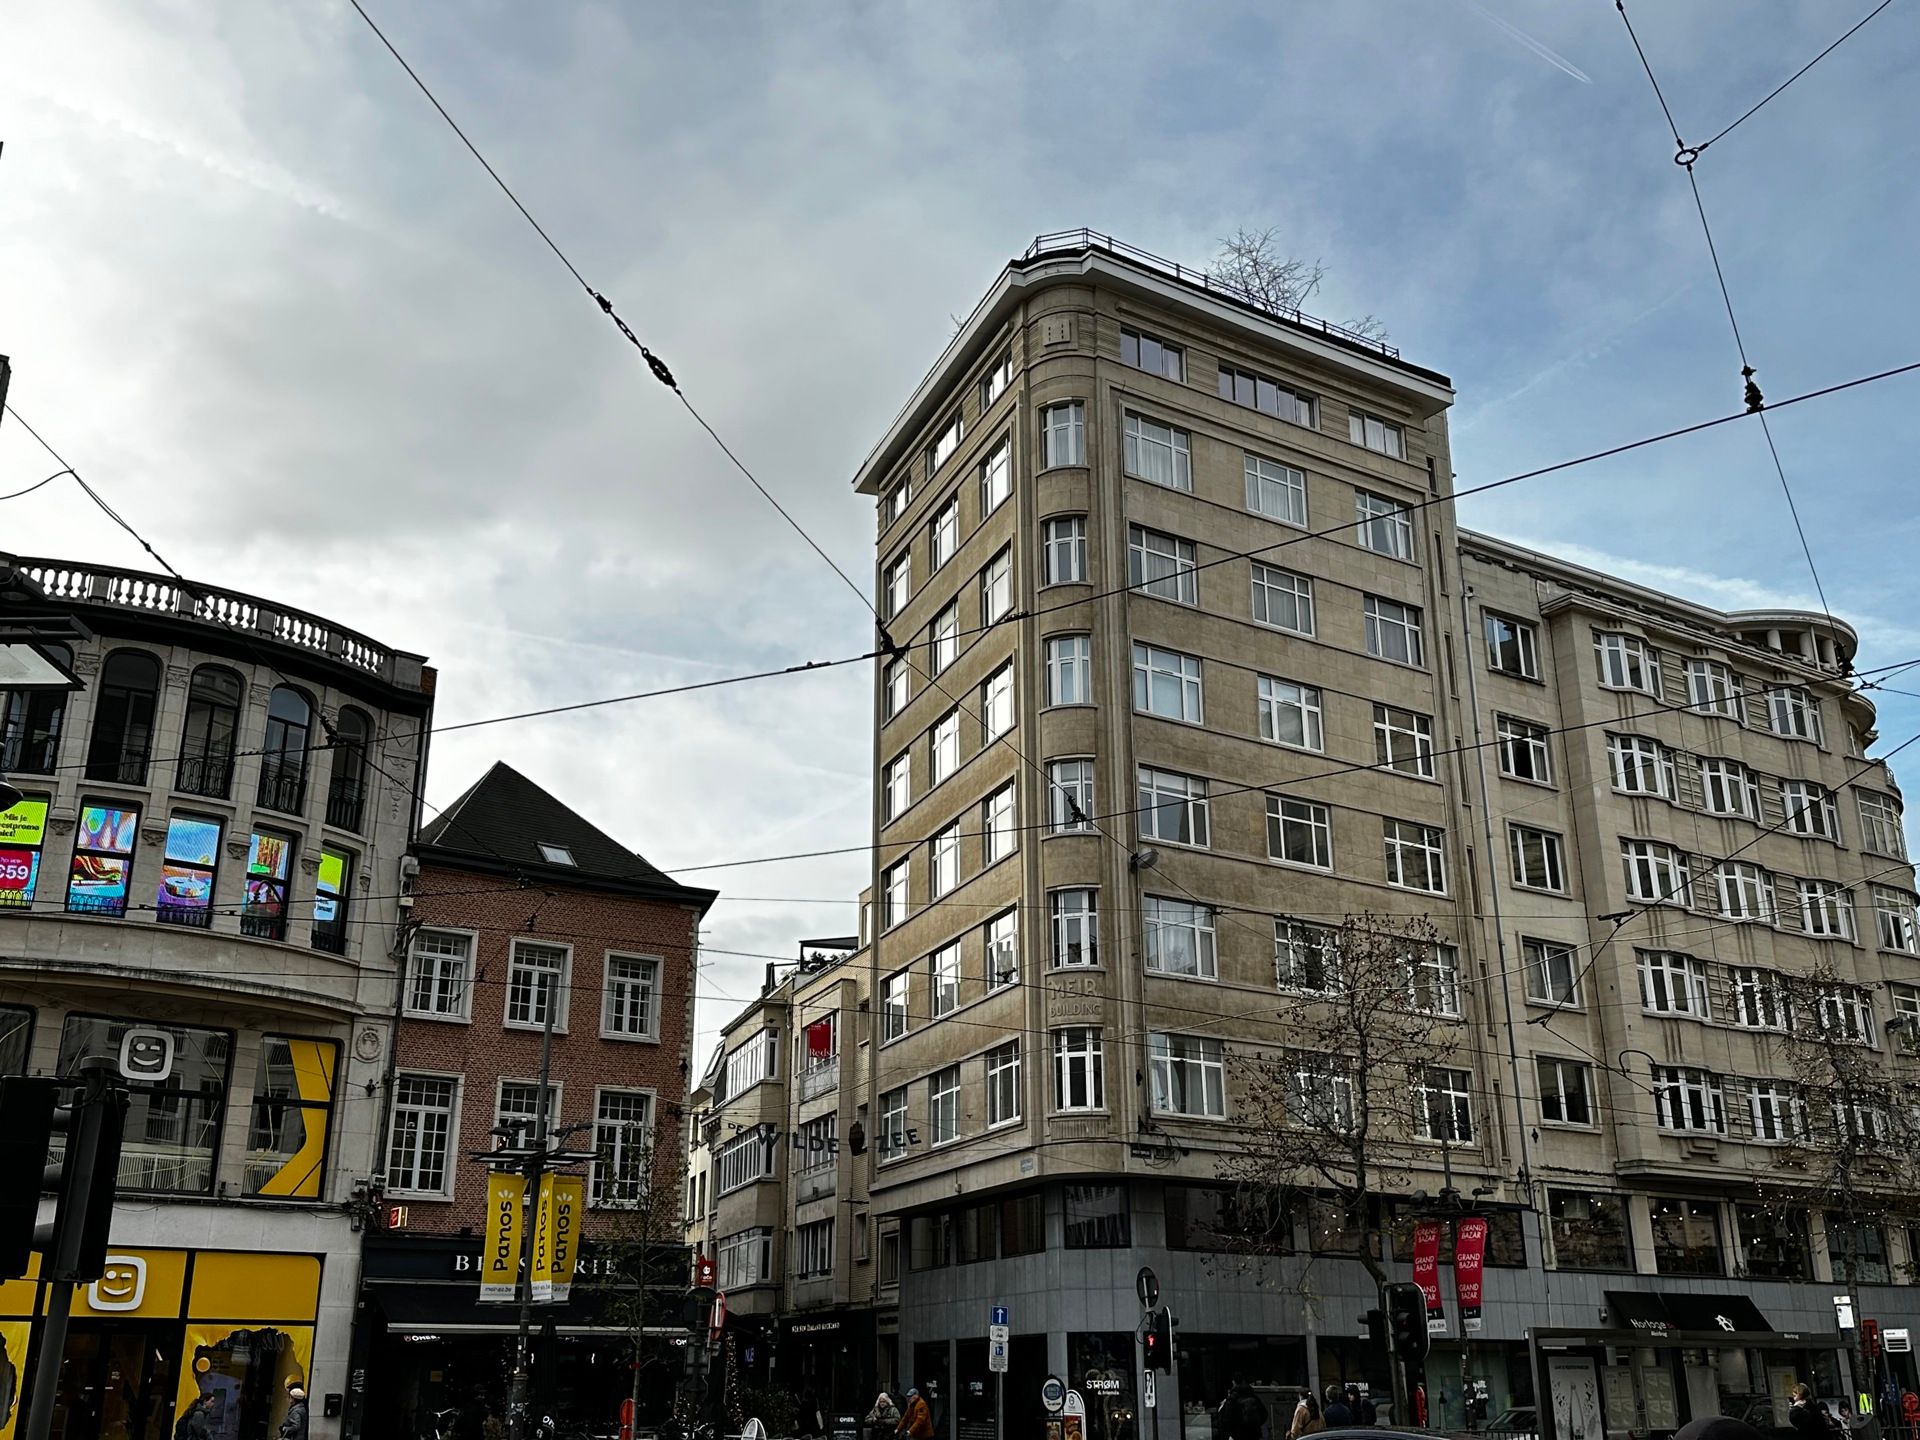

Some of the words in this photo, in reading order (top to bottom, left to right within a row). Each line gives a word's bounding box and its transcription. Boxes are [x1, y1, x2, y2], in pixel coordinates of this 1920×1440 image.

[1047, 977, 1099, 1000] MEIR
[1049, 1002, 1102, 1018] BUILDING
[727, 1122, 744, 1136] DE
[1416, 1227, 1438, 1236] GRAND
[1460, 1224, 1483, 1232] GRAND
[493, 1200, 513, 1272] Panos
[535, 1198, 548, 1272] Panos
[551, 1204, 571, 1274] Panos
[1418, 1235, 1436, 1243] BAZAR
[1461, 1231, 1481, 1240] BAZAR
[1415, 1256, 1435, 1264] GRAND
[1457, 1253, 1480, 1262] GRAND
[1416, 1263, 1433, 1272] BAZAR
[1458, 1260, 1479, 1269] BAZAR
[1458, 1283, 1479, 1292] GRAND
[1461, 1290, 1478, 1299] BAZAR
[1086, 1379, 1120, 1390] STRØM
